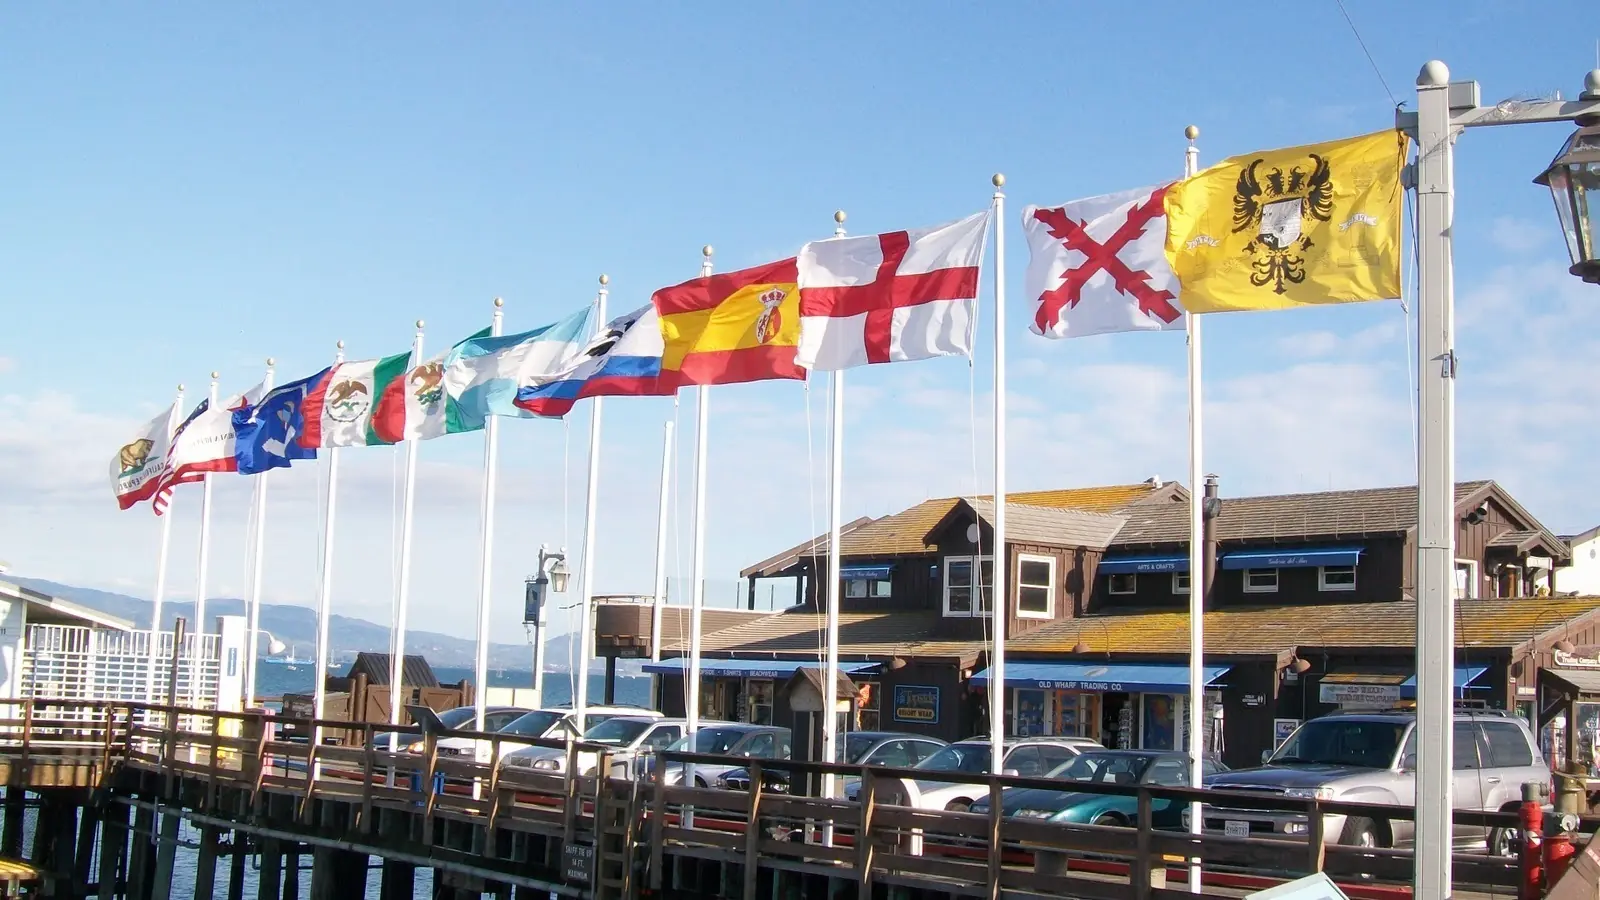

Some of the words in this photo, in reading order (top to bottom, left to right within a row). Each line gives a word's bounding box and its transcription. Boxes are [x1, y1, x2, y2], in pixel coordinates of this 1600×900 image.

[1055, 681, 1076, 689] WHARF
[1080, 682, 1108, 690] TRADING
[1111, 683, 1123, 691] CO.
[1361, 686, 1384, 694] WHARF
[1365, 695, 1397, 703] COMPANY
